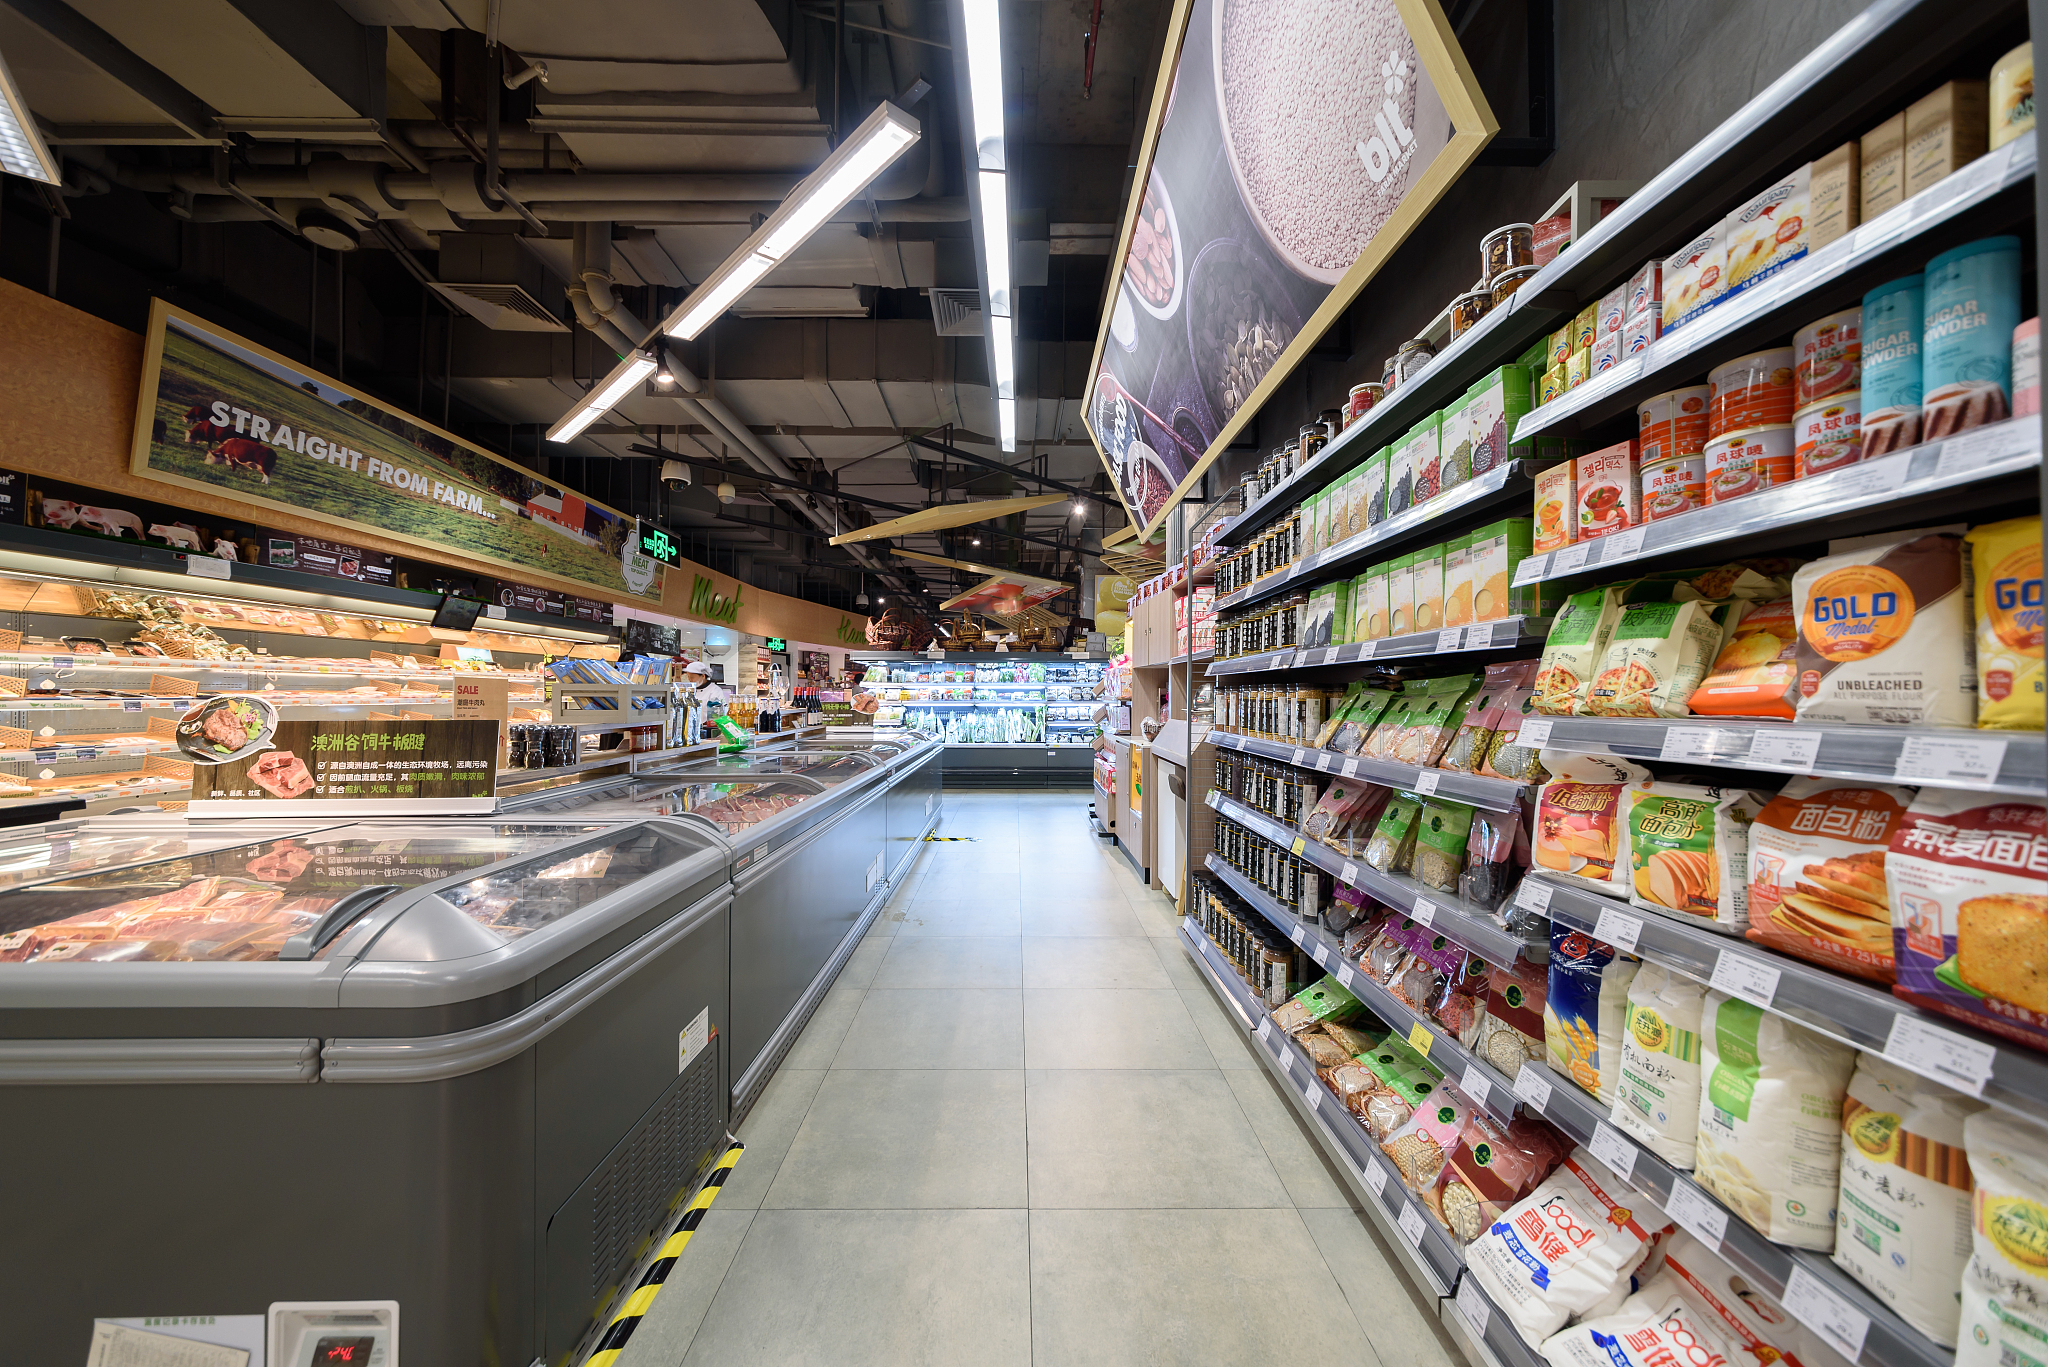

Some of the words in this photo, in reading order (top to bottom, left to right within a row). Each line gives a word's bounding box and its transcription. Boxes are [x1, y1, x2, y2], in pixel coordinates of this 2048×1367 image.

[1355, 98, 1414, 182] blt
[1377, 168, 1396, 198] FARM
[1390, 139, 1419, 176] MARKET
[1743, 187, 1789, 220] mauripan
[1675, 239, 1711, 269] mauripan
[1626, 315, 1648, 334] Angel
[1925, 299, 1979, 330] SUGAR
[1594, 336, 1614, 352] Angel
[1862, 330, 1911, 358] SUGAR
[1113, 392, 1128, 449] FOOD
[208, 399, 363, 474] STRAIGHT
[366, 455, 429, 497] FROM
[433, 480, 497, 520] FARM...
[1583, 456, 1605, 478] 젤리
[631, 555, 650, 570] MEAT
[688, 573, 745, 624] Meat
[1813, 591, 1897, 622] GOLD
[1825, 618, 1875, 640] Medal
[457, 685, 479, 695] SALE
[1833, 692, 1847, 700] ALL
[1850, 692, 1887, 700] PURPOSE
[1892, 691, 1924, 701] FLOUR
[1837, 679, 1923, 690] UNBLEACHED
[1790, 803, 1891, 841] 面包粉
